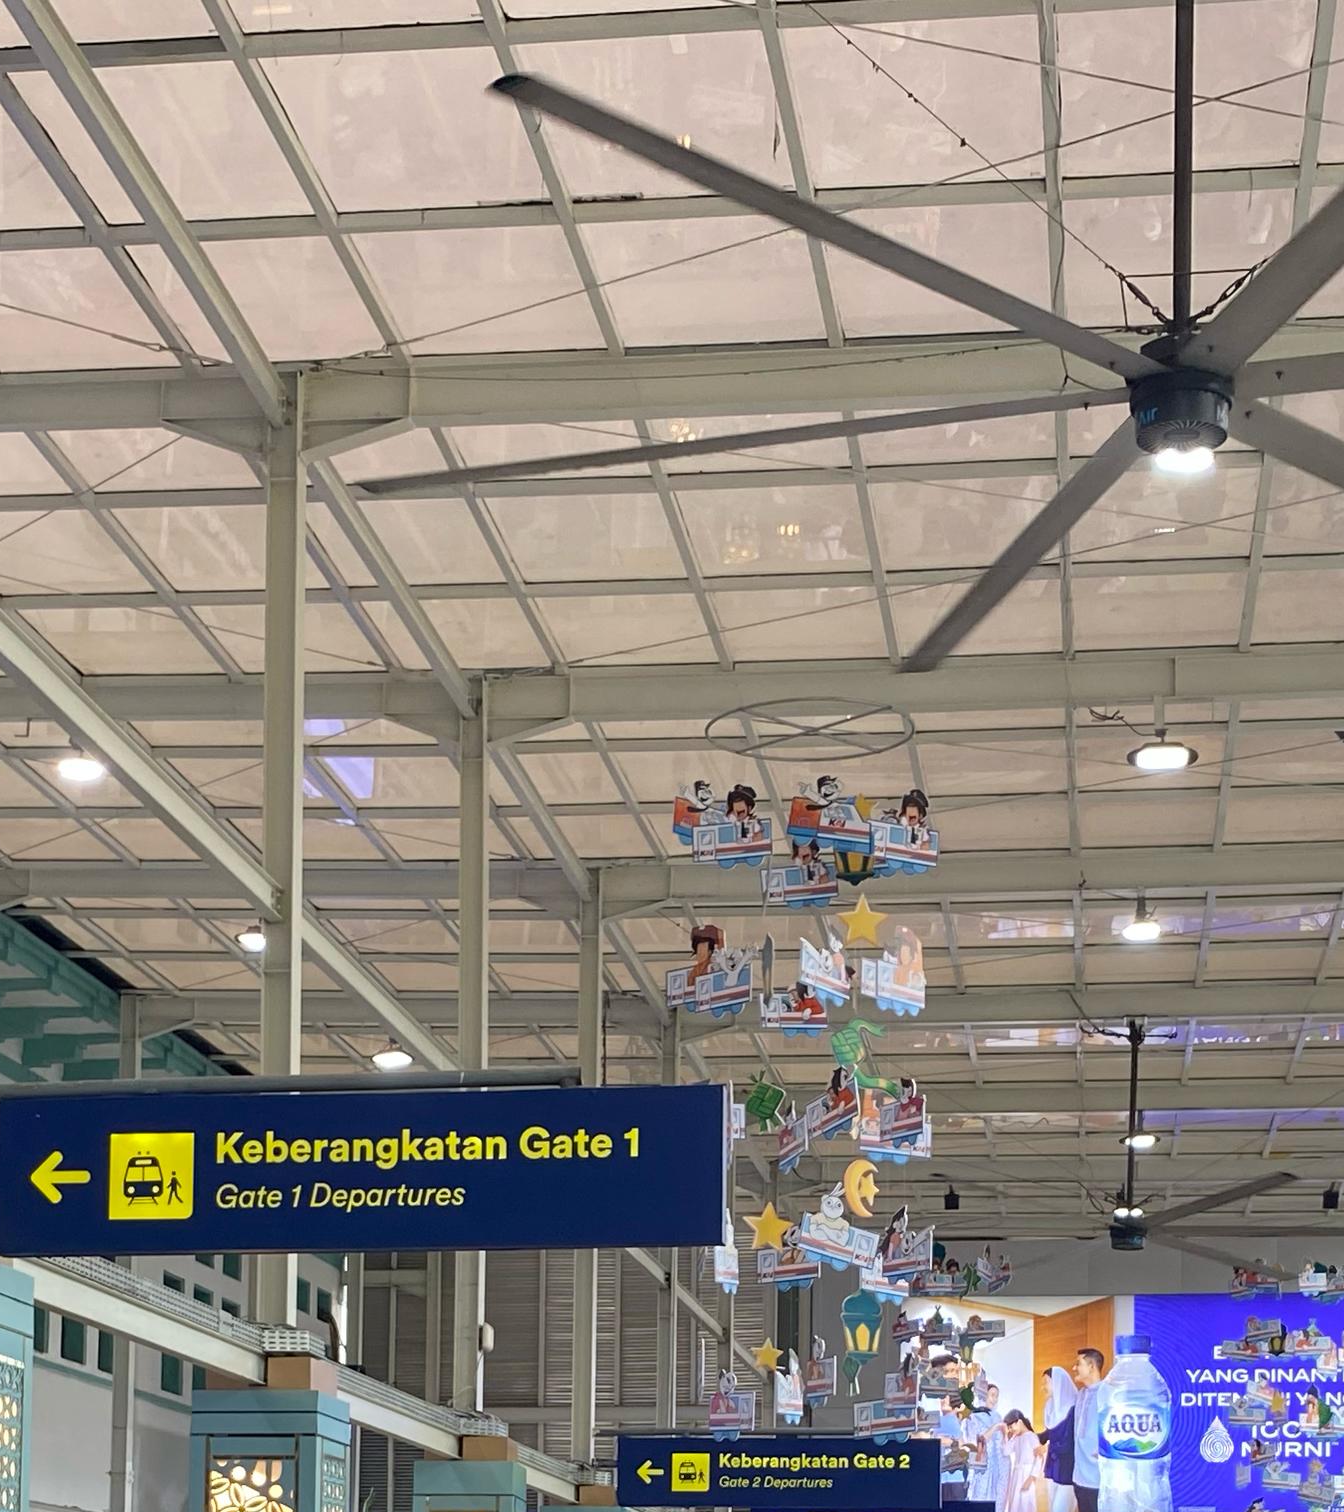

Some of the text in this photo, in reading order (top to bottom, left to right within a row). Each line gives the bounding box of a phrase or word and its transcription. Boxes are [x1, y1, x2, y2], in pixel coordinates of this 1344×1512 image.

[216, 1125, 641, 1170] Keberangkatan Gate 1
[215, 1181, 466, 1213] Gate 1 Departures
[1186, 1368, 1248, 1383] YANG
[1107, 1413, 1162, 1437] AQUA
[718, 1453, 911, 1472] Keberangkatan Gate 2
[718, 1476, 834, 1490] Gate 2 Departures
